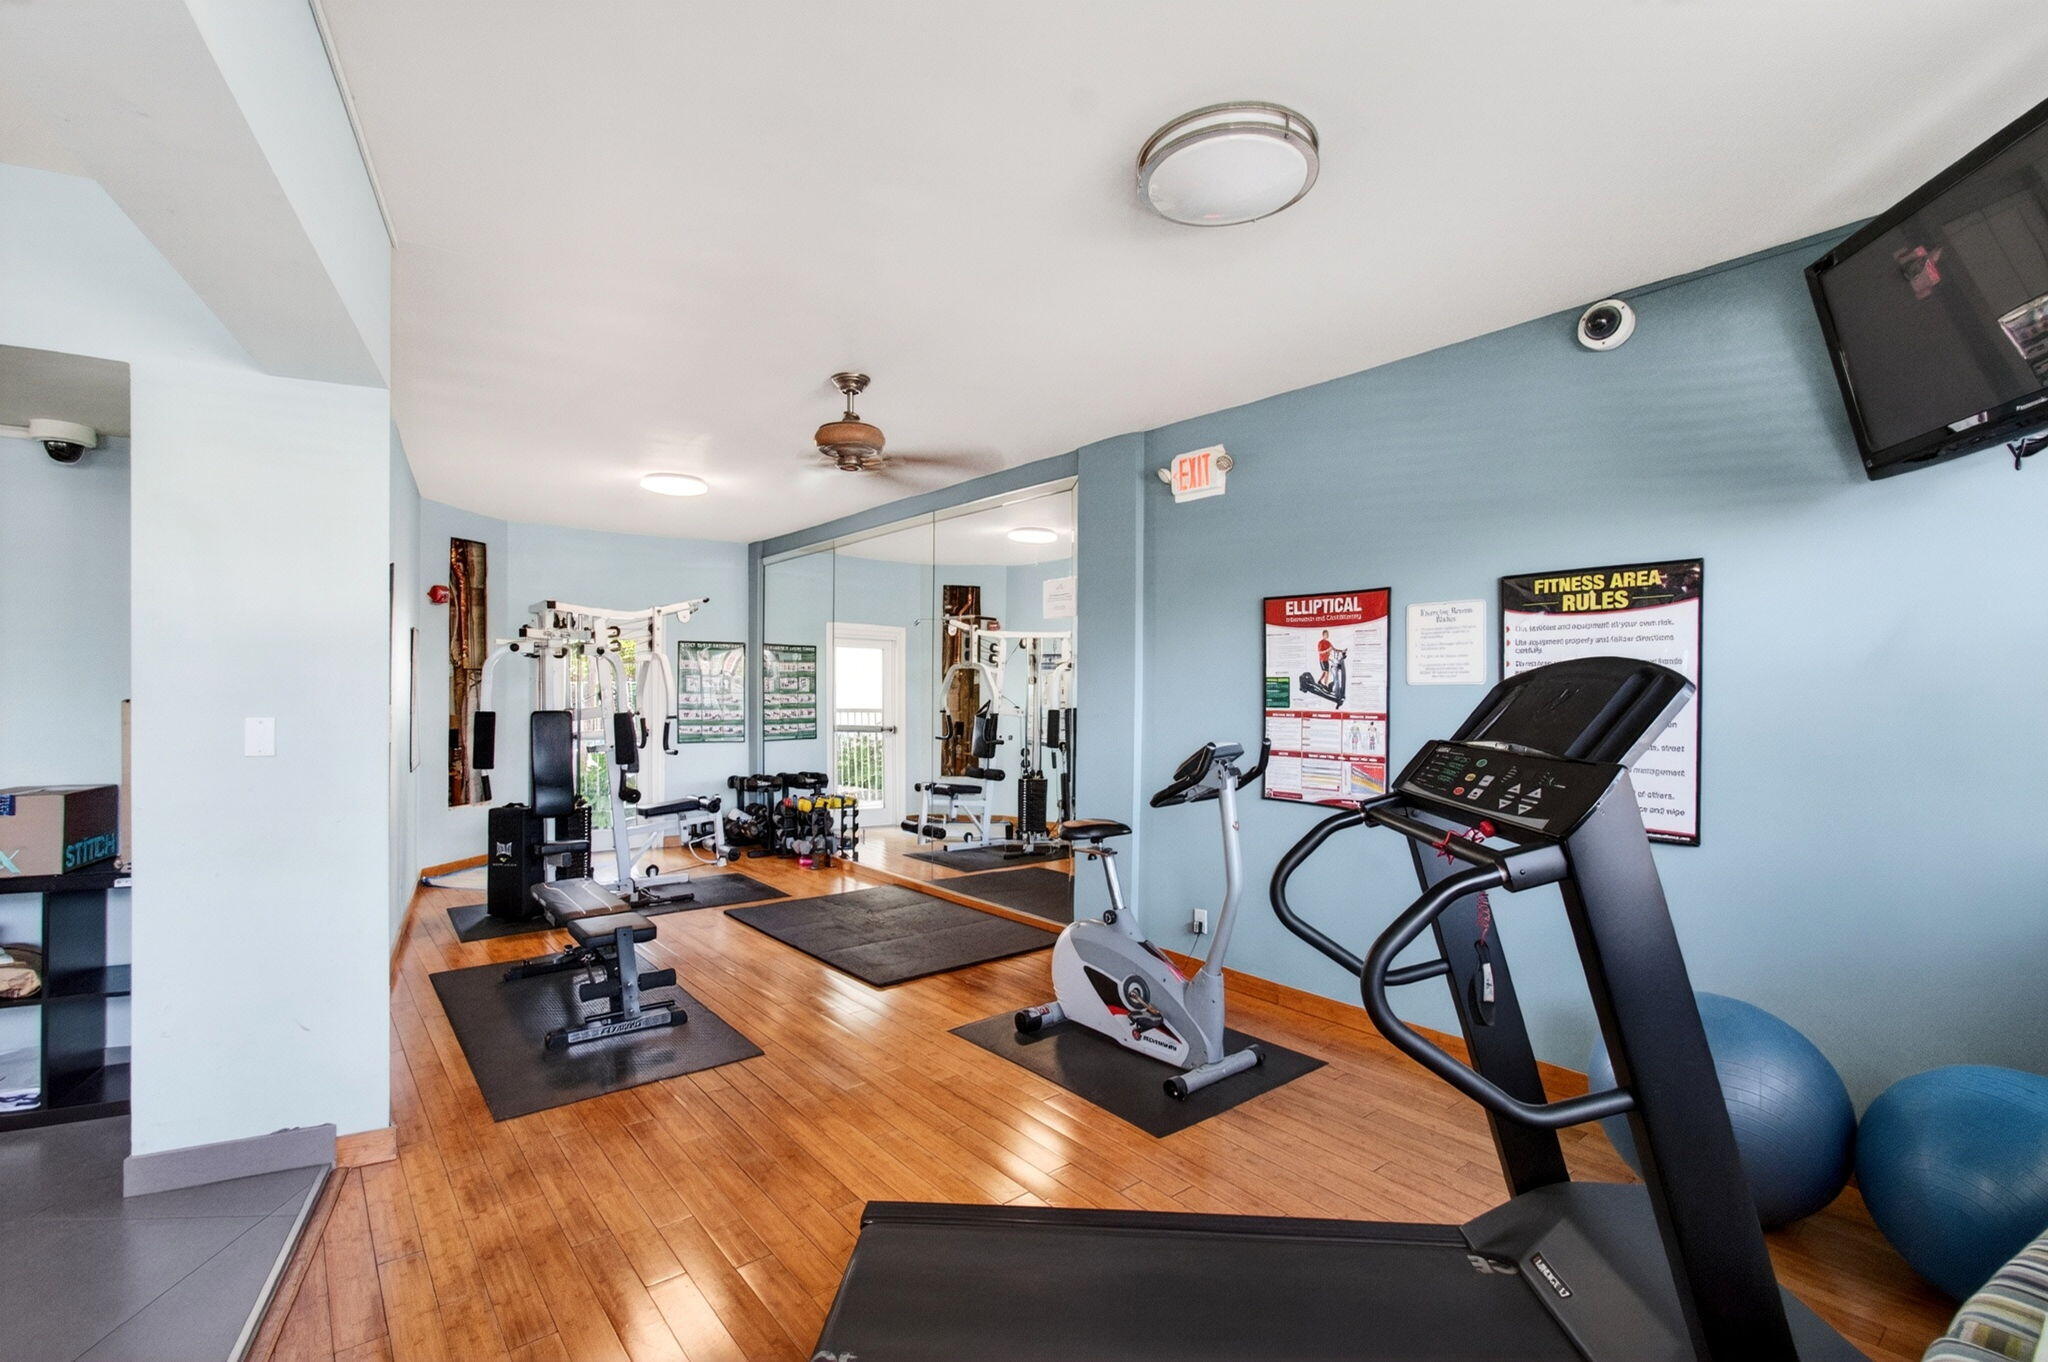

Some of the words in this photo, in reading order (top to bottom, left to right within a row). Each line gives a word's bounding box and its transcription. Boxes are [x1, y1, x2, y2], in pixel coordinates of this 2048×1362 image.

[1178, 453, 1211, 491] EXIT
[1534, 574, 1605, 595] FITNESS
[1610, 569, 1662, 588] AREA
[1285, 596, 1363, 616] ELLIPTICAL
[1562, 590, 1629, 612] RULES
[1620, 621, 1637, 629] your
[1565, 637, 1593, 645] properly
[1649, 806, 1665, 815] and
[1666, 808, 1686, 817] wipe
[65, 832, 116, 868] STITCH
